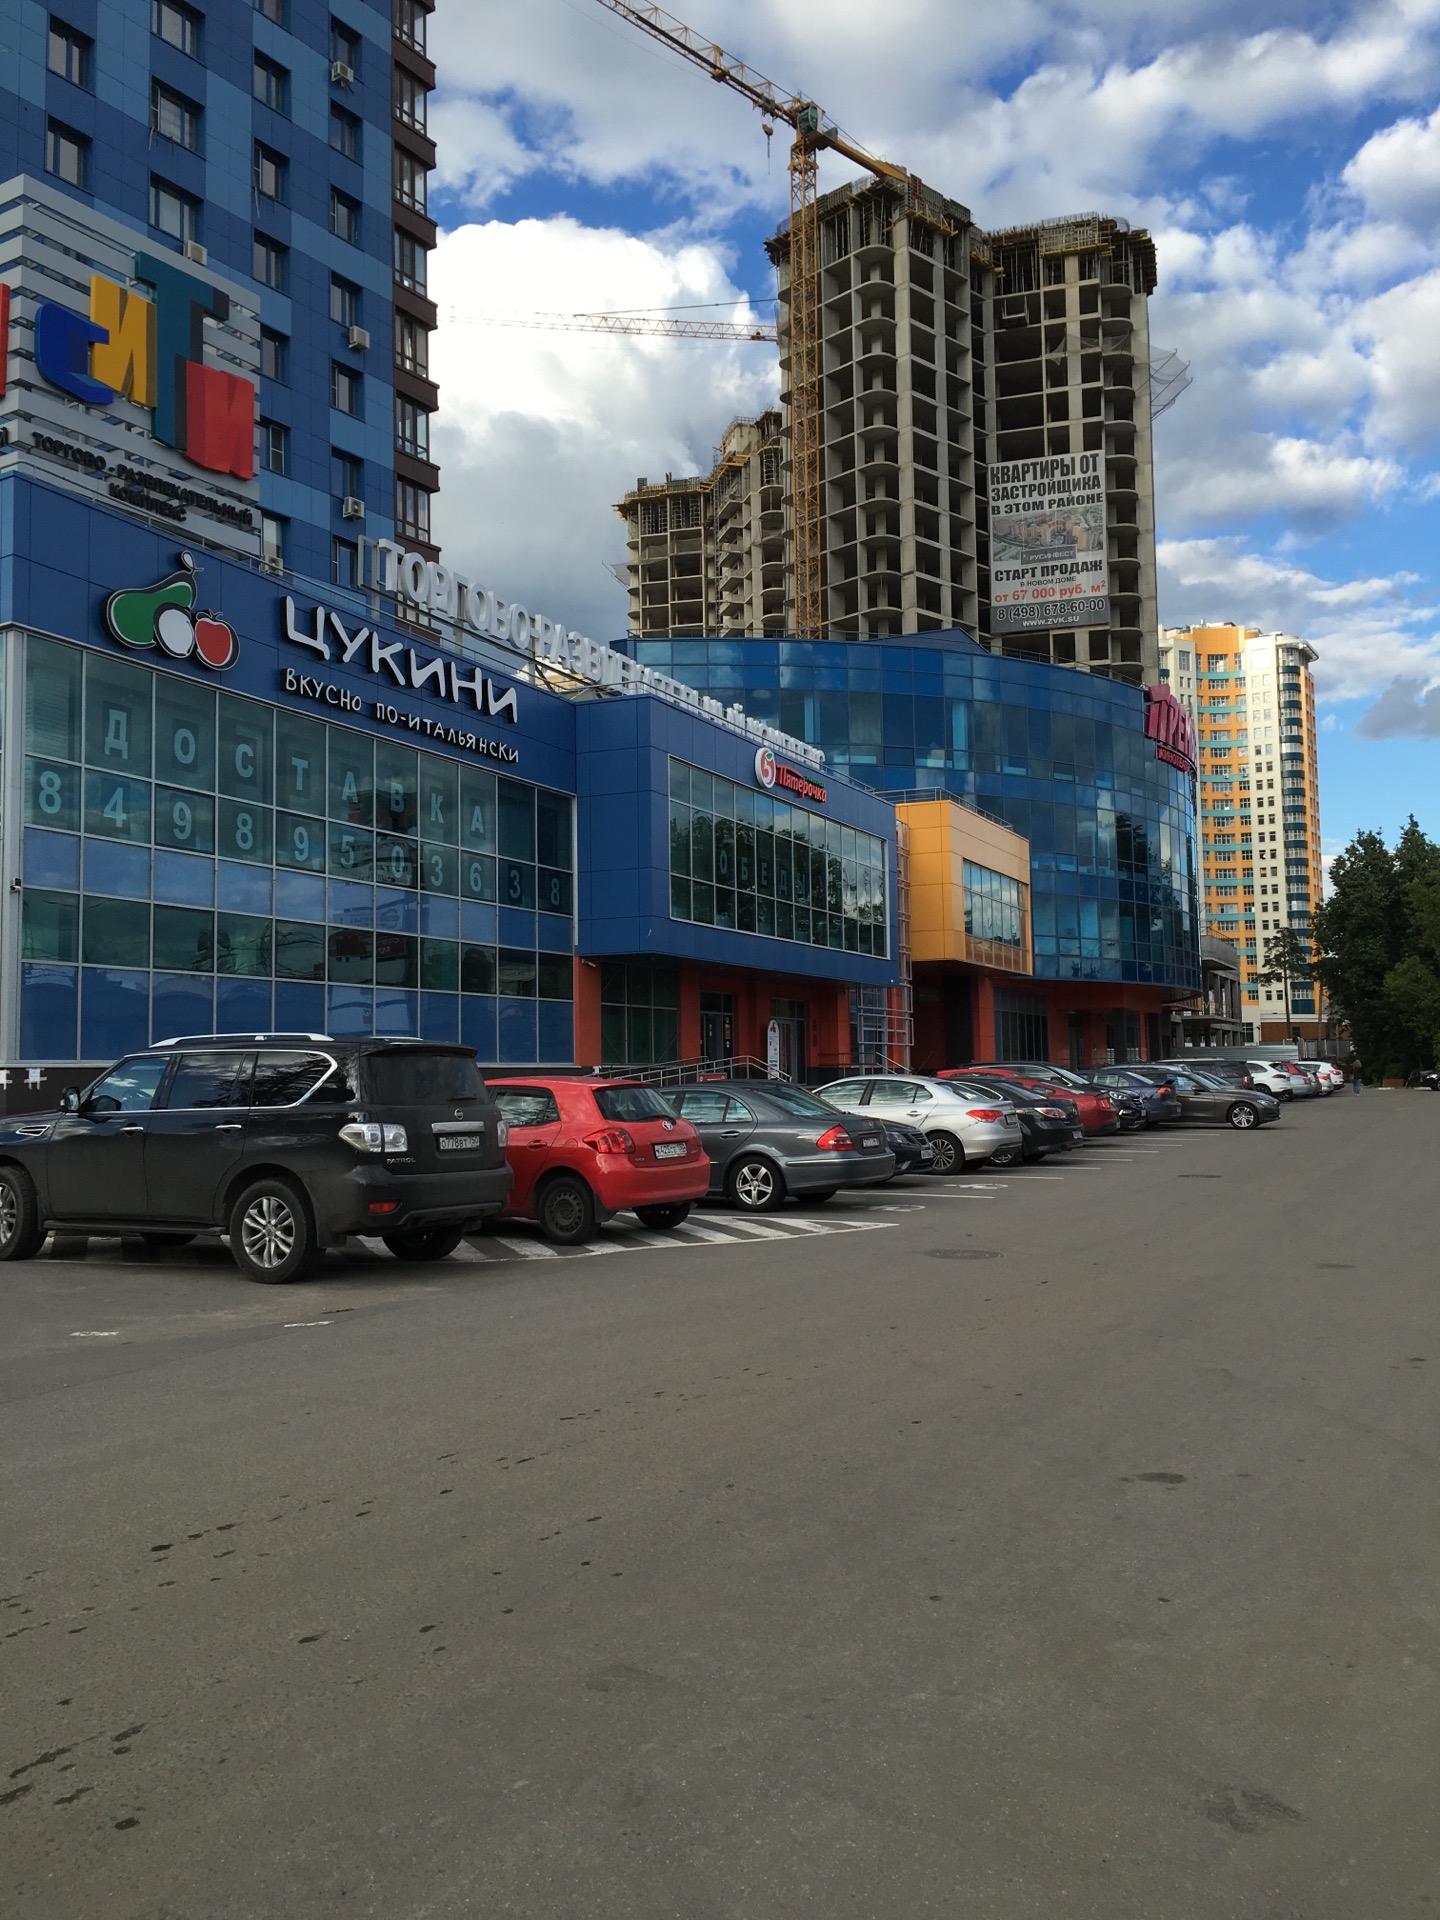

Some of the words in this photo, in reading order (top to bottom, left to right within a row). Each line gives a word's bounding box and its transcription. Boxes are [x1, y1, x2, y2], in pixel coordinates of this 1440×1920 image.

[35, 250, 256, 481] СИТИ
[990, 456, 1075, 486] КВАРТИРЫ
[1079, 453, 1099, 474] ОТ
[991, 475, 1101, 502] ЗАСТРОЙЩИКА
[992, 506, 1001, 515] В
[1004, 501, 1044, 515] ЭТОМ
[1049, 492, 1103, 510] РАЙОНЕ
[994, 566, 1037, 582] СТАРТ
[1040, 559, 1102, 577] ПРОДАЖ
[1027, 578, 1054, 587] НОВОМ
[1055, 576, 1076, 584] ДОМЕ
[994, 594, 1008, 603] от
[1012, 590, 1028, 601] 67
[1031, 587, 1055, 600] 000
[1059, 583, 1087, 598] руб.
[998, 608, 1006, 621] 8
[1009, 605, 1040, 622] (498)
[1044, 598, 1106, 616] 678-60-00
[284, 594, 519, 724] ЦУКИНИ
[776, 764, 828, 803] Пятерочка
